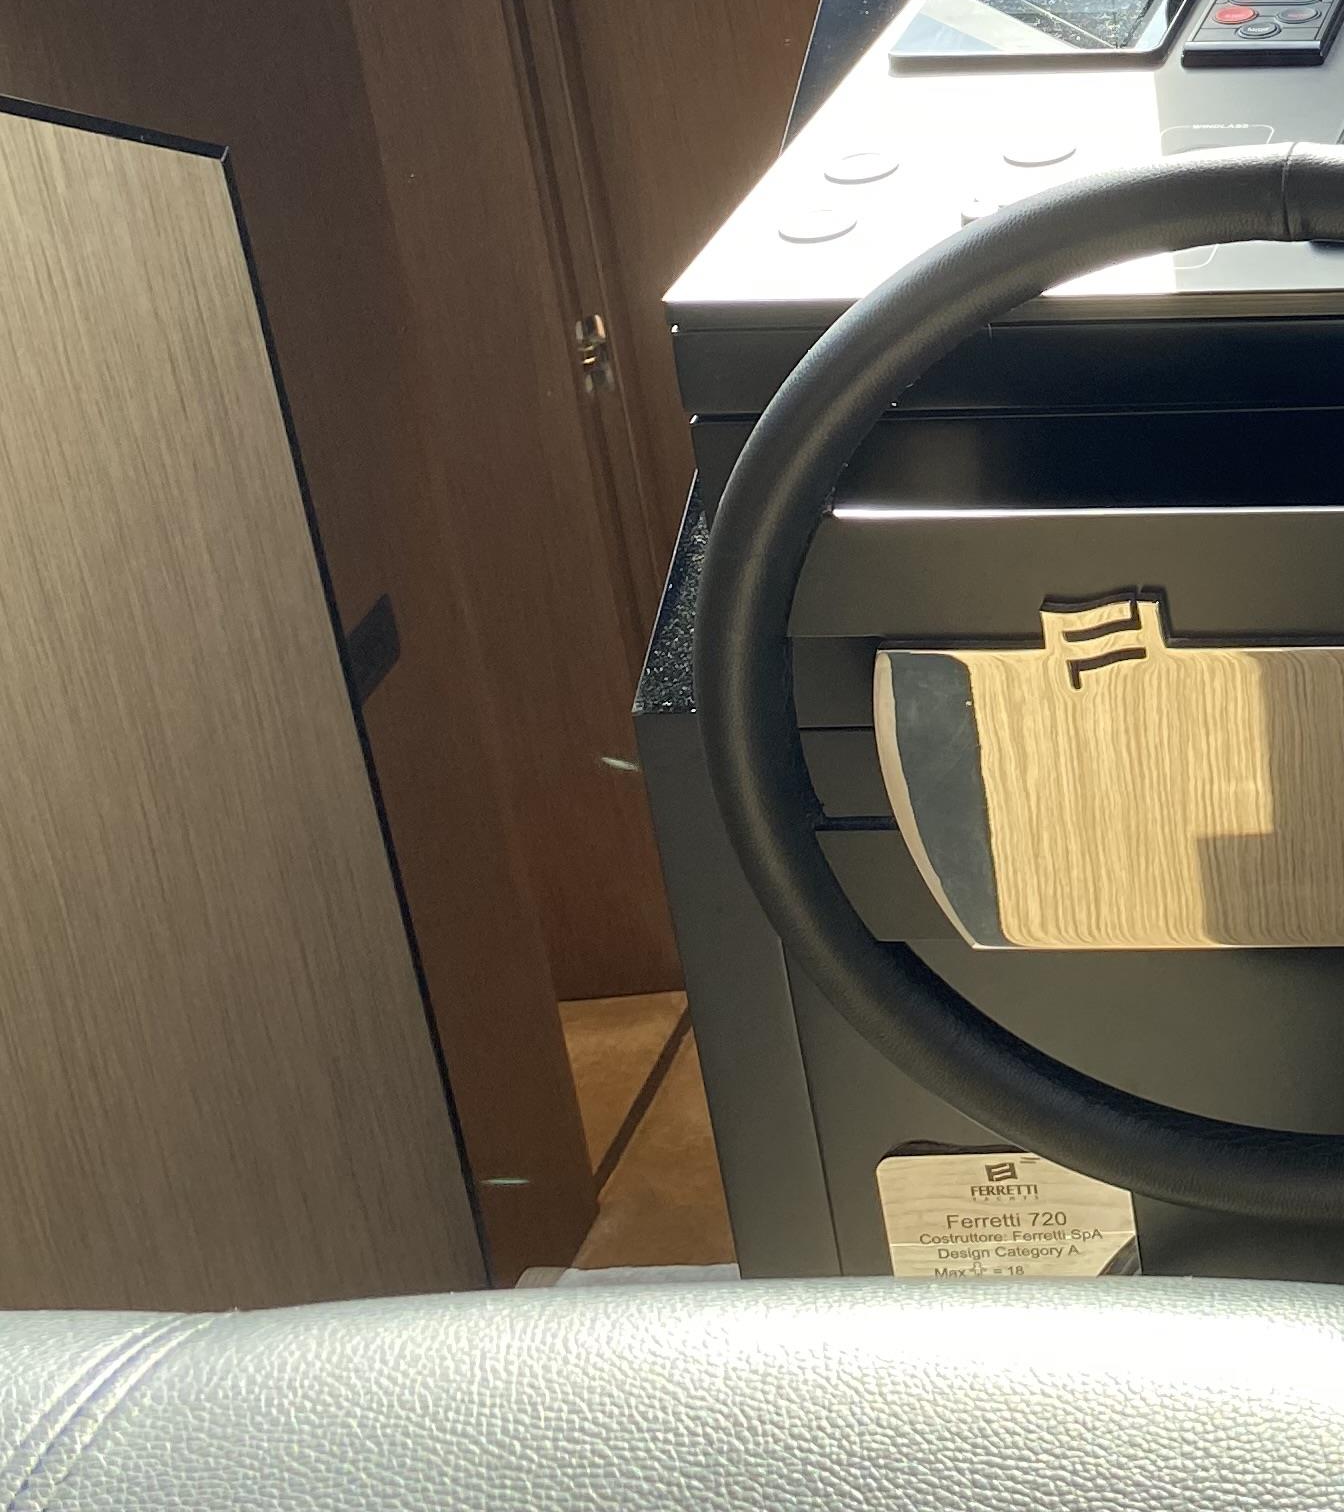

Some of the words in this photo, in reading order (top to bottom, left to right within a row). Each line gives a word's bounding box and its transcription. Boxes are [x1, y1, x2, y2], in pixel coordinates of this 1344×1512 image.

[970, 1184, 1039, 1197] FERRETTI
[946, 1212, 1021, 1230] Ferretti
[1028, 1211, 1068, 1227] 720
[919, 1232, 1007, 1245] Costruttore:
[1012, 1230, 1067, 1243] Ferretti
[1071, 1228, 1103, 1244] SpA
[937, 1246, 990, 1261] Design
[995, 1244, 1063, 1260] Category
[1066, 1244, 1081, 1256] A
[934, 1265, 966, 1278] Max
[1007, 1265, 1025, 1276] 18
